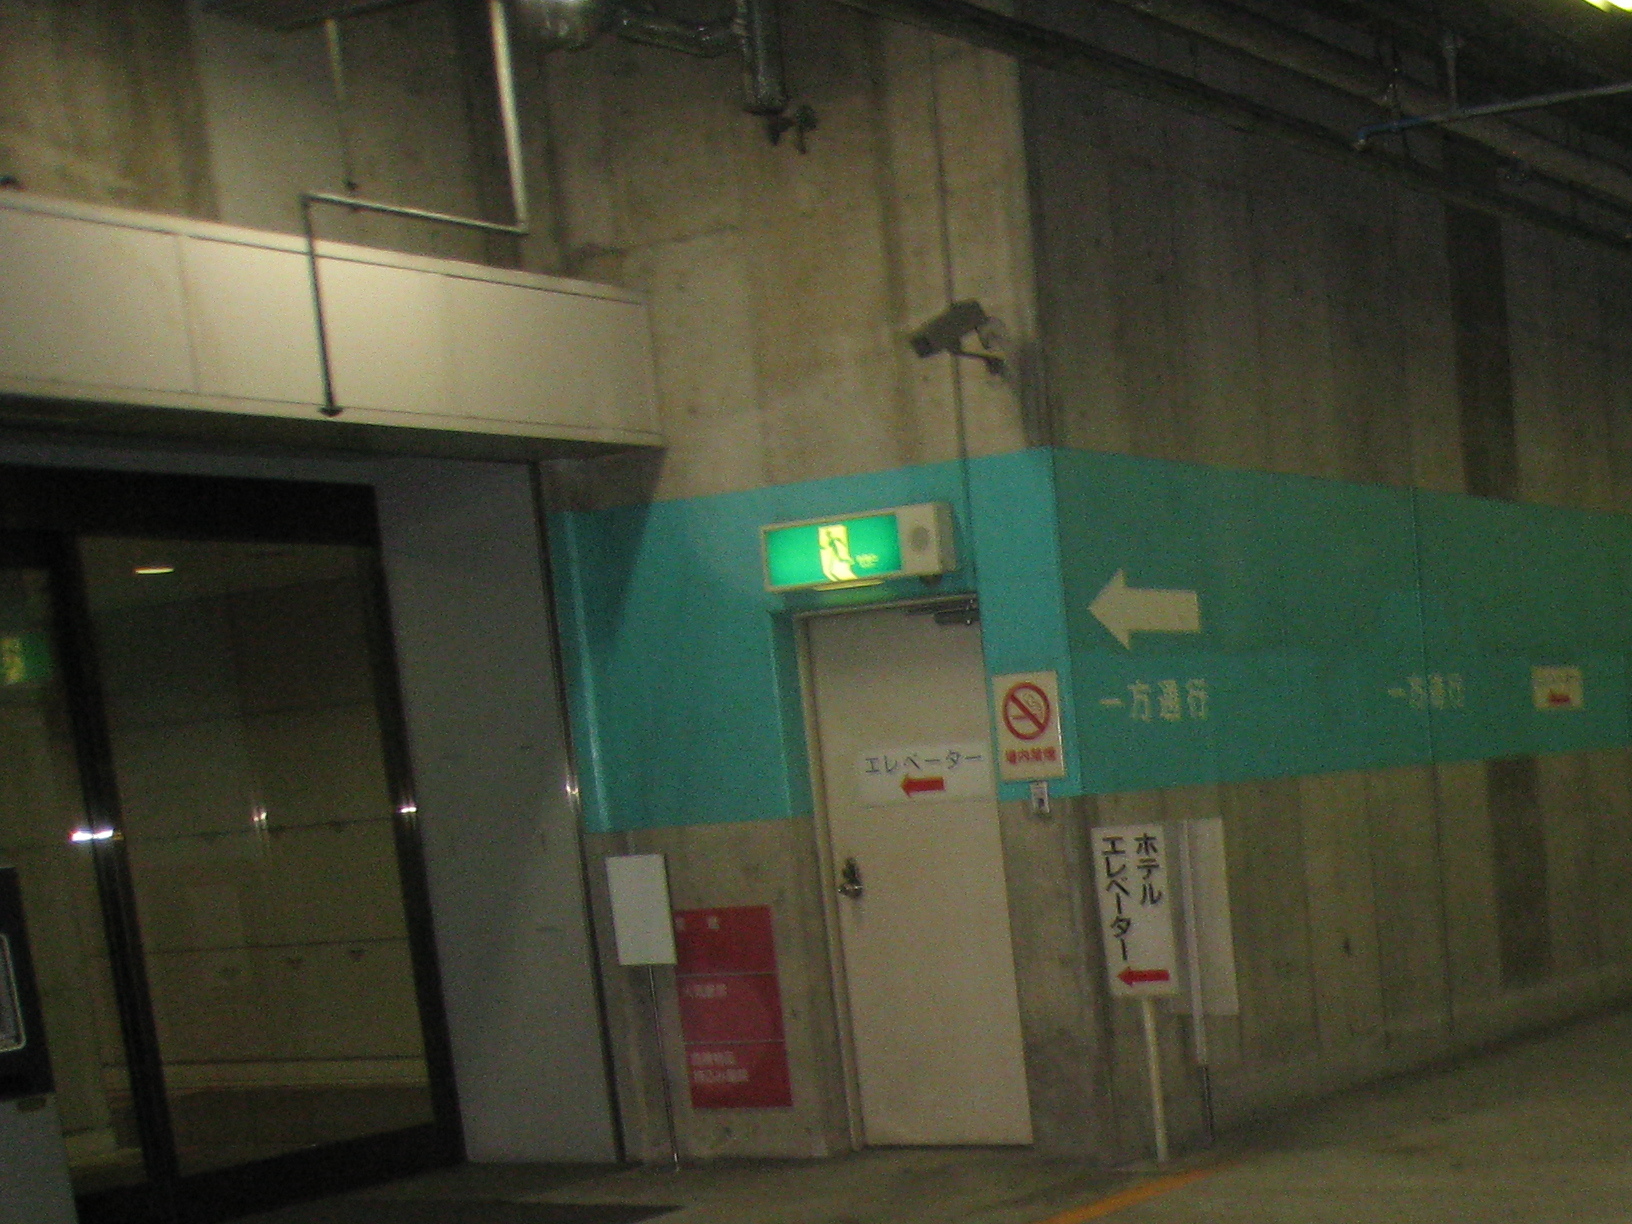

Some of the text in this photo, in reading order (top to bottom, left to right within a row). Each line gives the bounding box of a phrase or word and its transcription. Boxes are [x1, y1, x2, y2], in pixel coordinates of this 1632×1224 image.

[1099, 678, 1209, 722] 一方通行
[864, 749, 983, 774] エレベーター
[1134, 832, 1162, 905] ホテル
[1102, 835, 1131, 961] エレベーター
